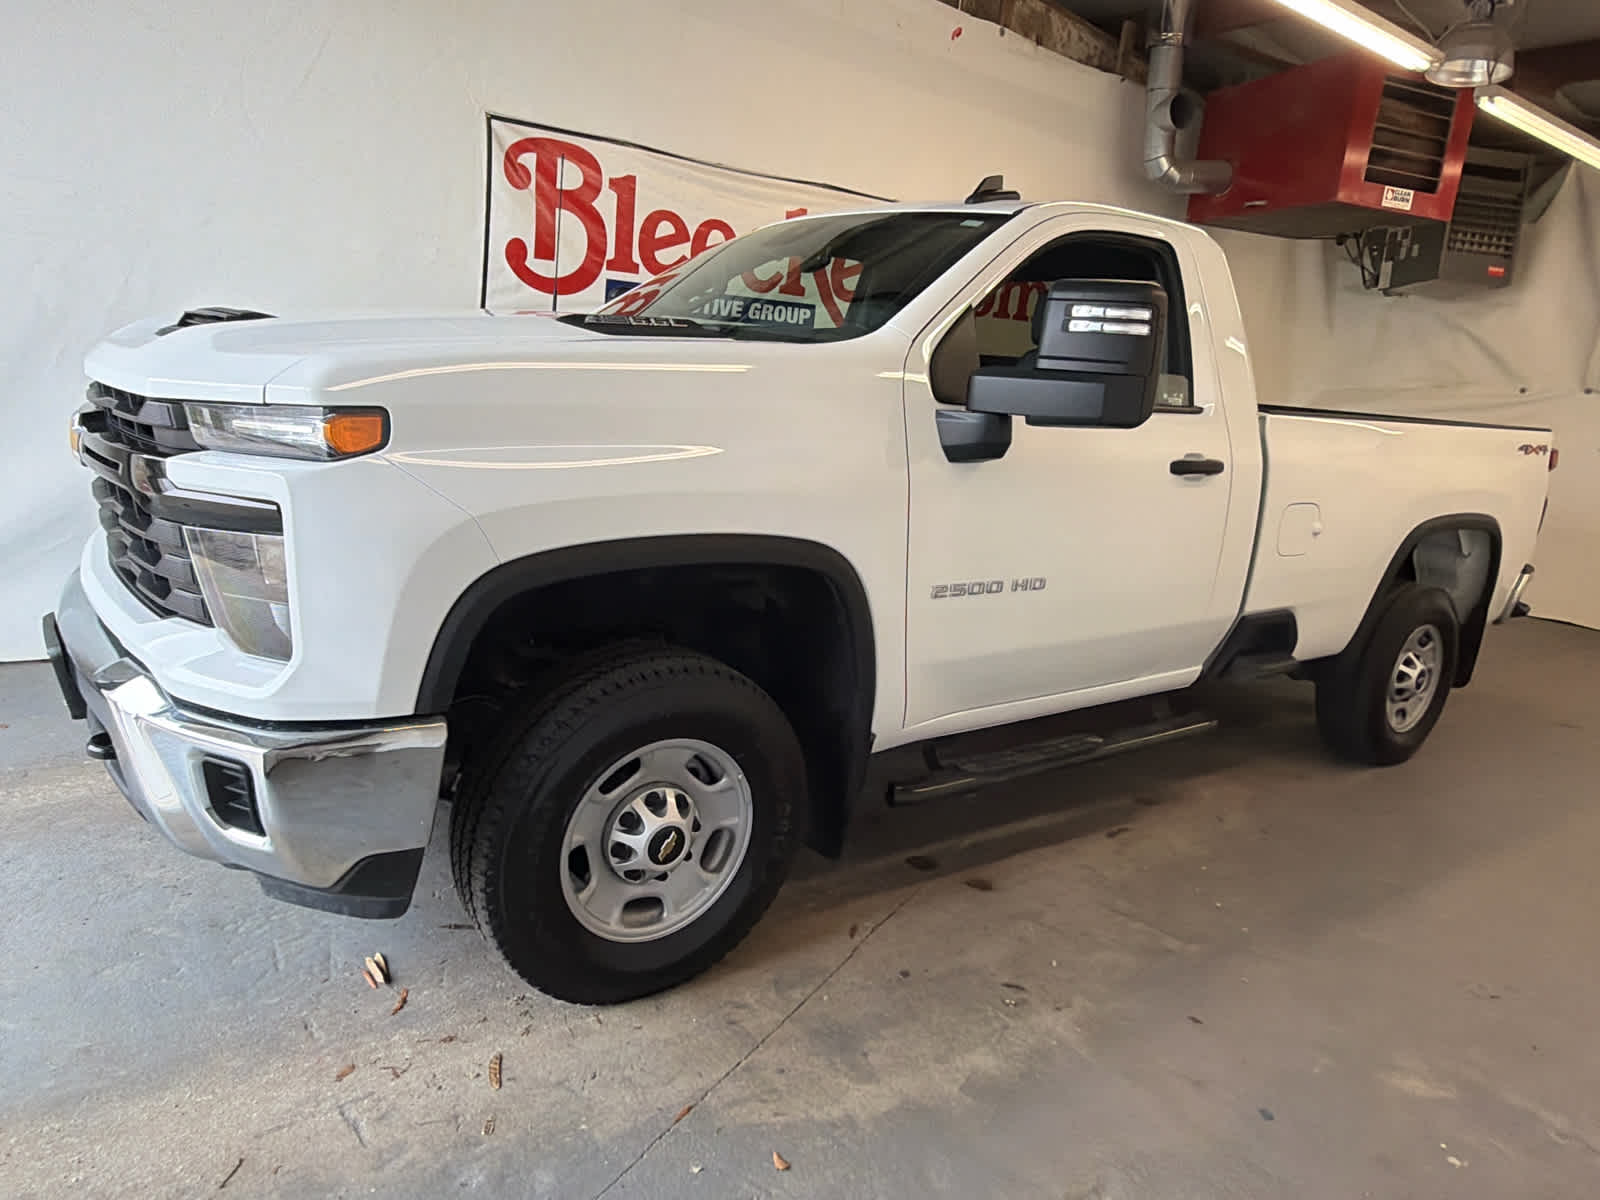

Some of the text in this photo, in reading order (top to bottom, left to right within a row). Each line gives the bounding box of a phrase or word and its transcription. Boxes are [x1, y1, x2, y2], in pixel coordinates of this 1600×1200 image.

[748, 302, 811, 325] GROUP
[931, 577, 1046, 599] 2500 HD
